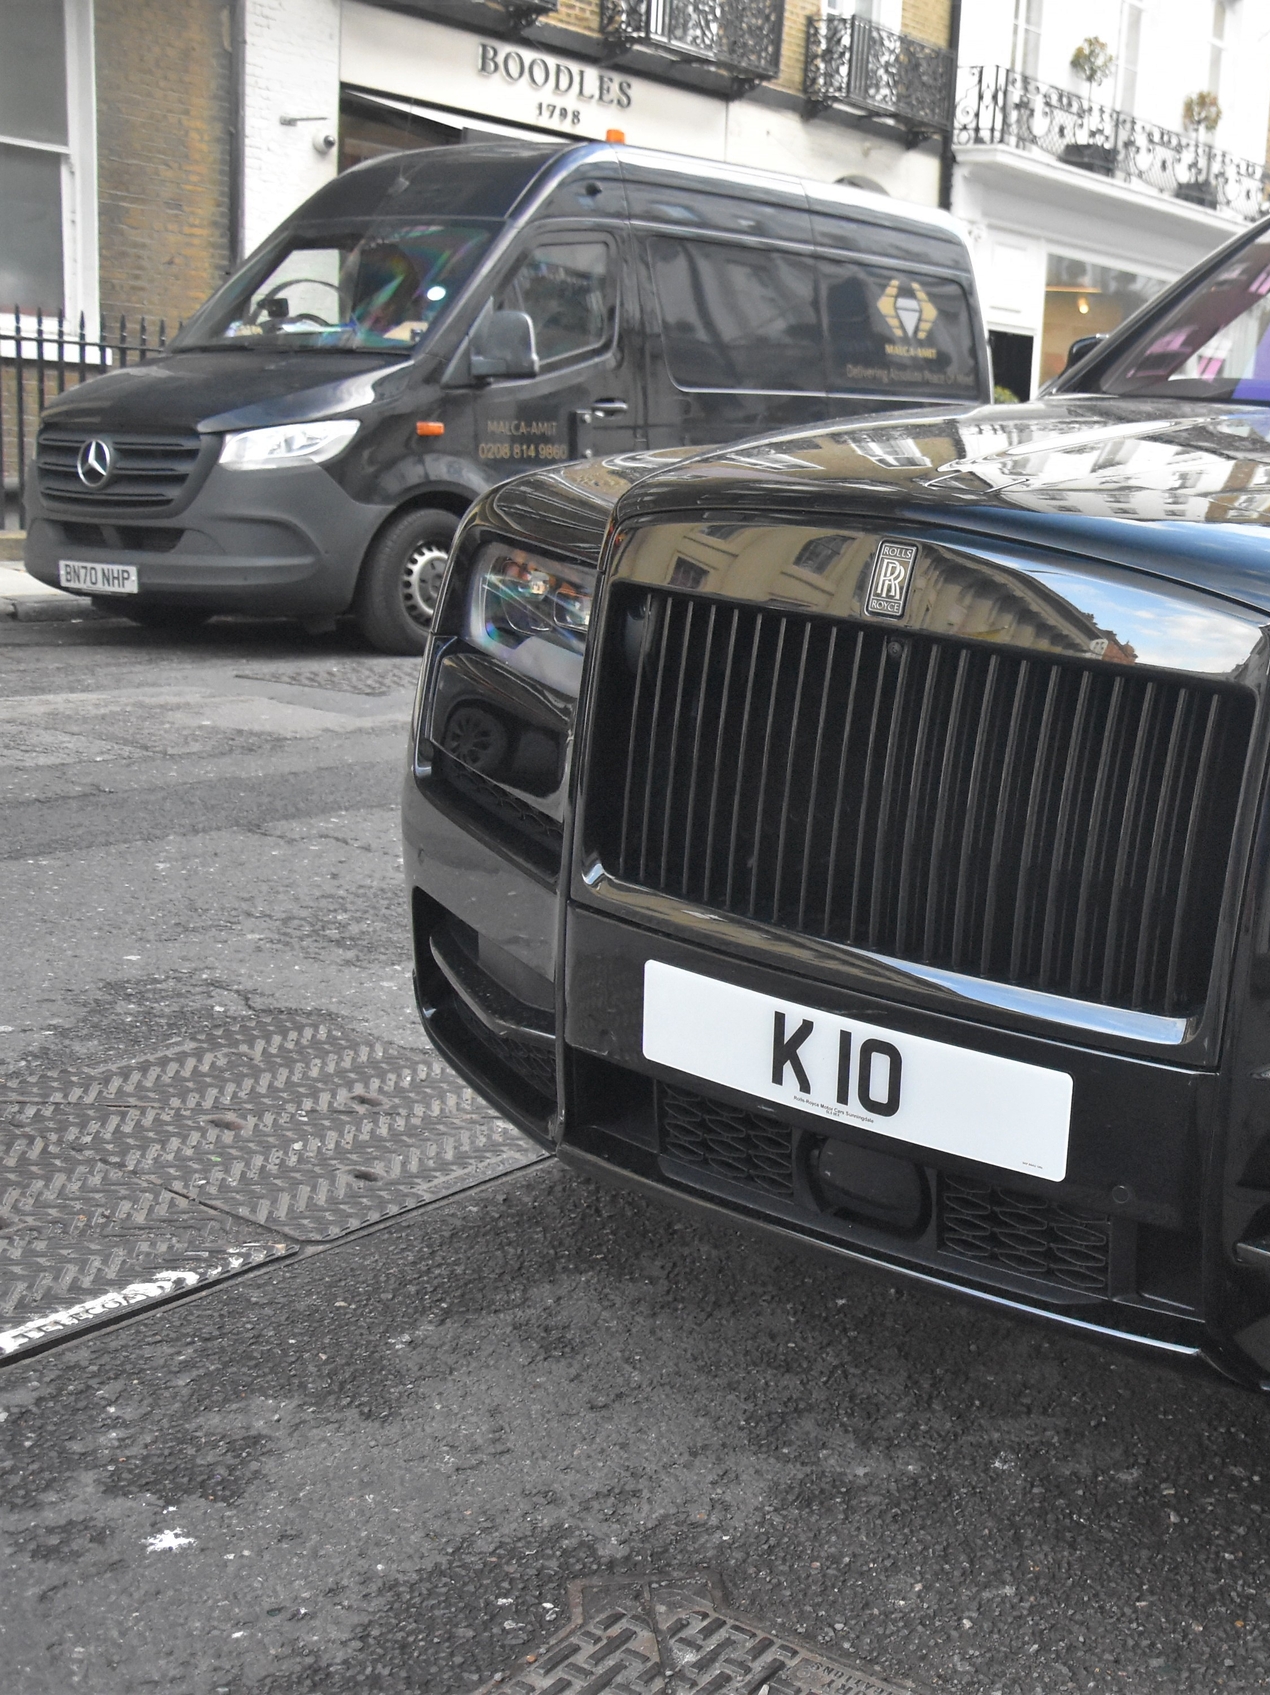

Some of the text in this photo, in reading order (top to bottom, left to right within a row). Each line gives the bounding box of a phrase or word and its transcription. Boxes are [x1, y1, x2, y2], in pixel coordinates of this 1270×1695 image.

[478, 43, 632, 109] BOODLES
[537, 102, 581, 125] 1798
[487, 421, 558, 436] MALCA-AMIT
[479, 443, 568, 460] 0208 814 9860
[883, 546, 912, 559] ROLLS
[64, 563, 131, 589] BN70 NHP
[871, 600, 900, 612] ROYCE
[772, 1010, 903, 1118] K 10
